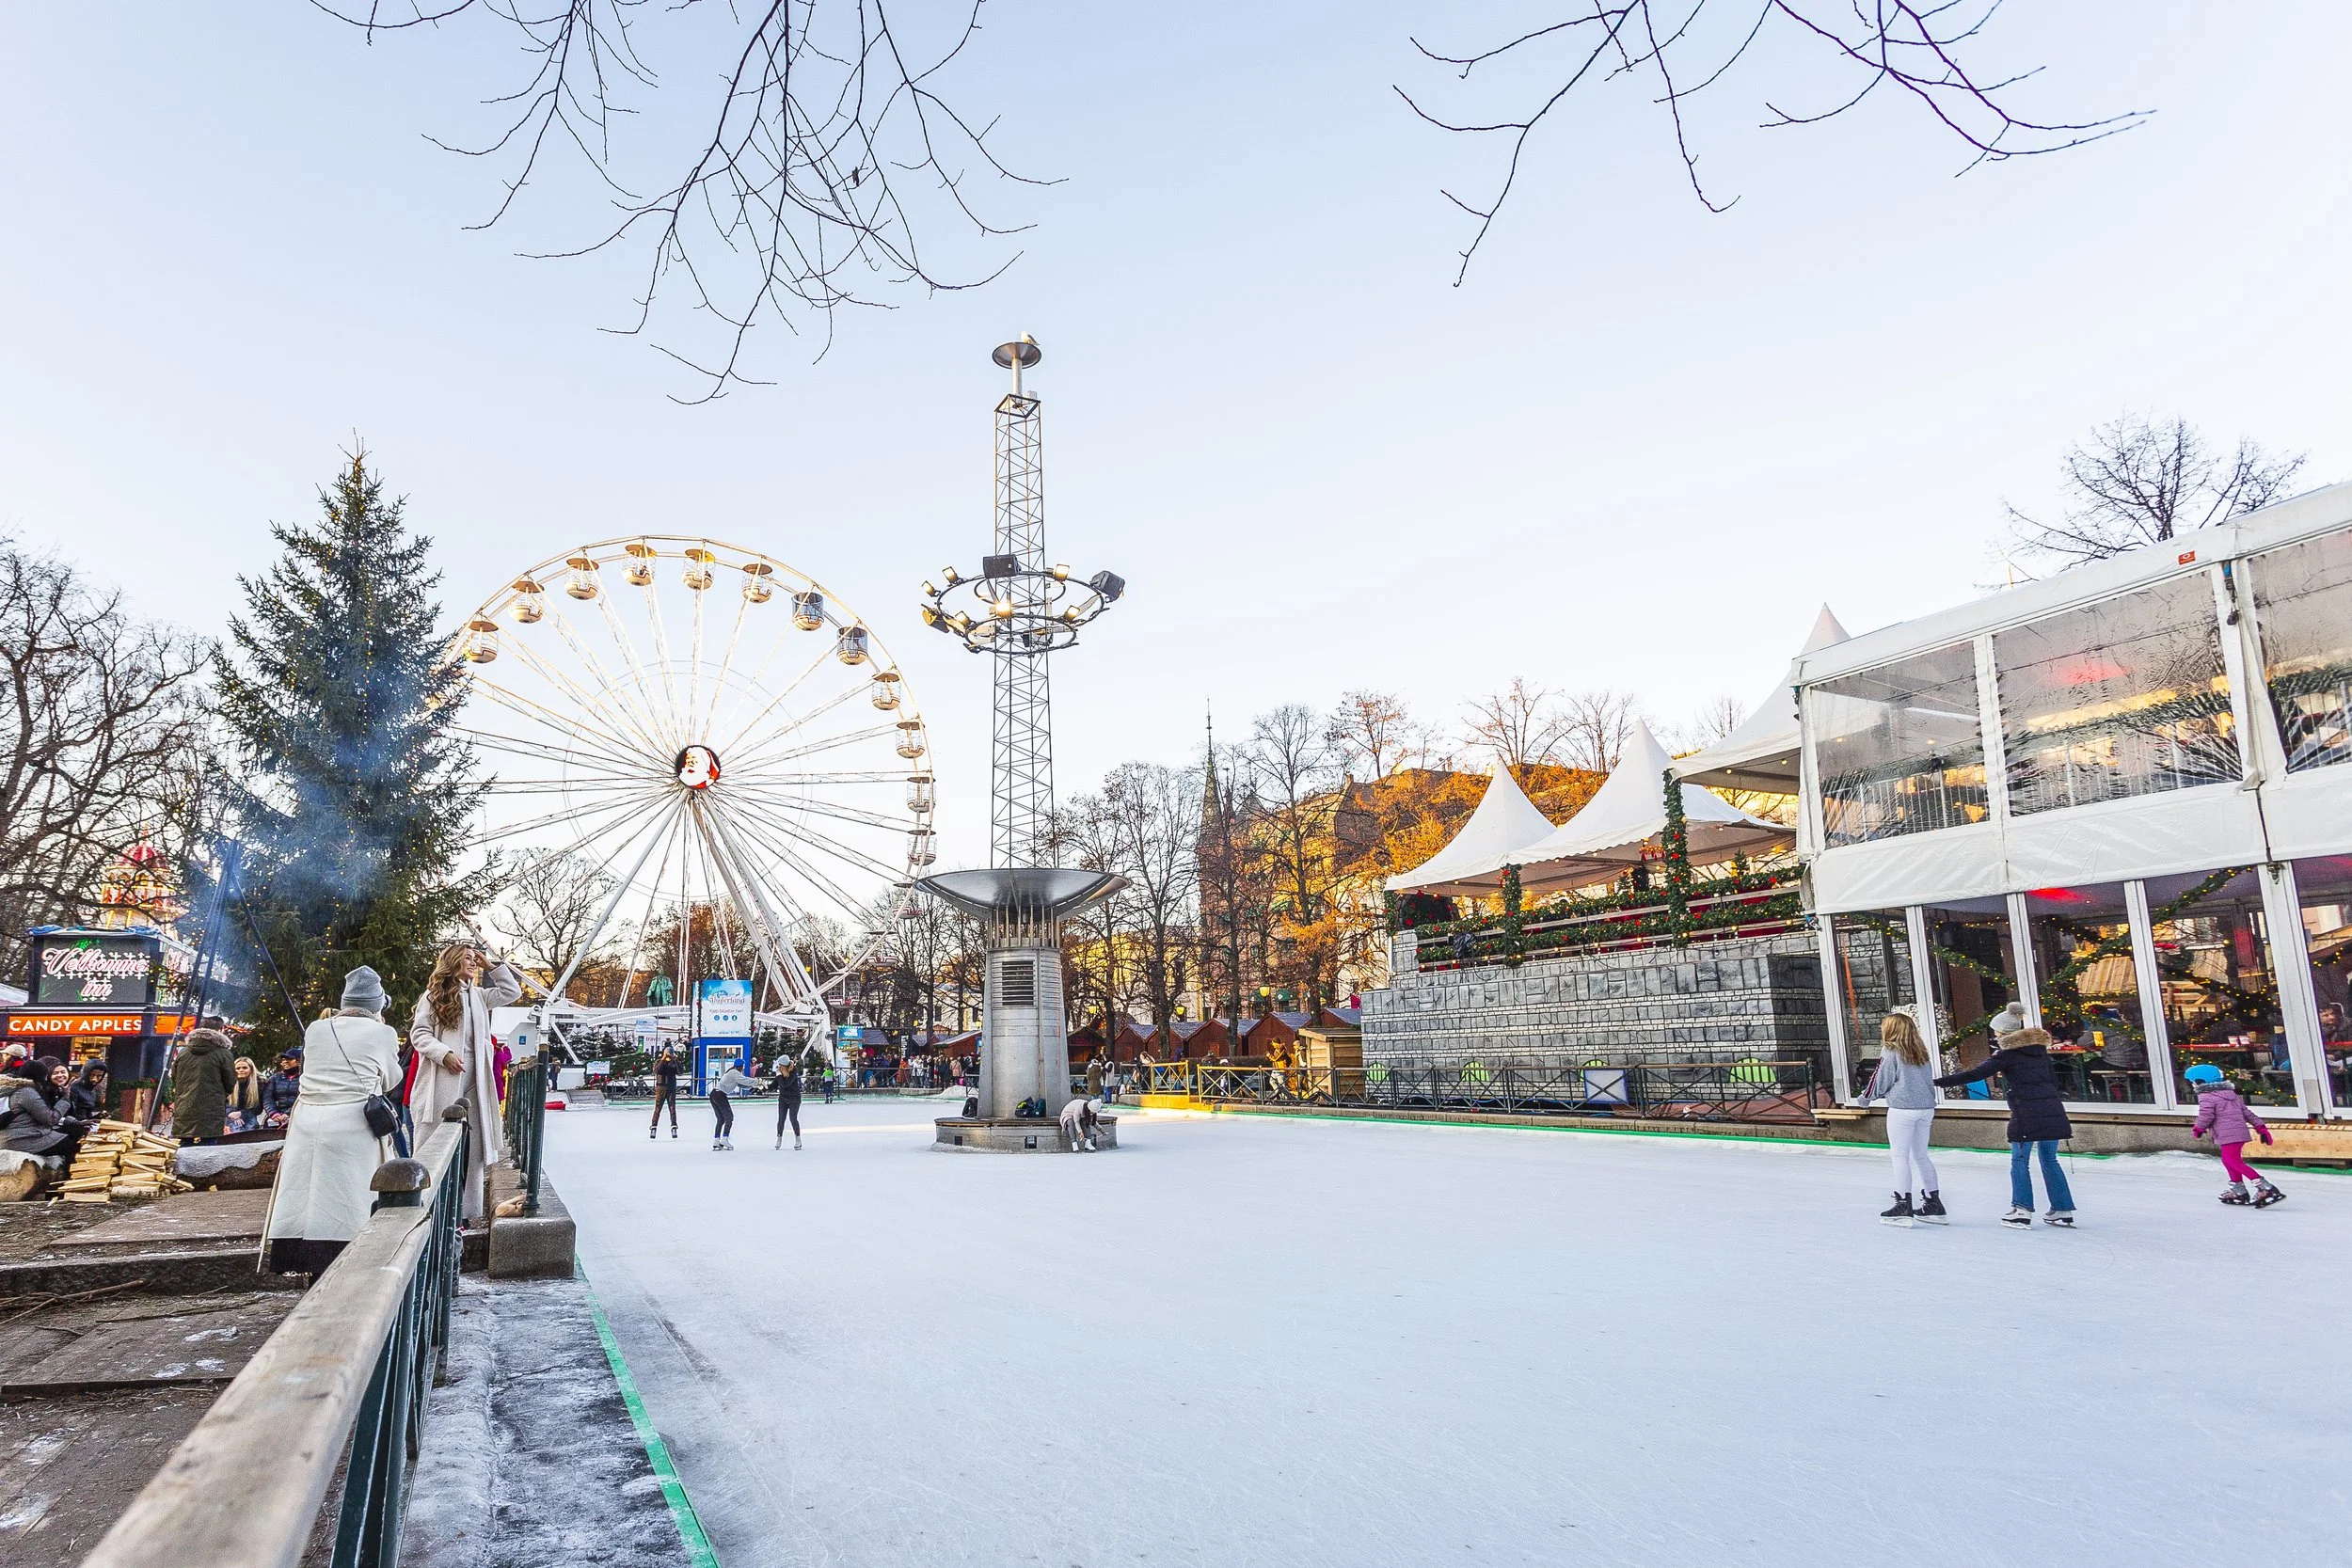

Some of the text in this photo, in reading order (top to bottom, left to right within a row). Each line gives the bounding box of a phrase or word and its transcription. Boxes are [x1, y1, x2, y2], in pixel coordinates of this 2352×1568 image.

[81, 980, 113, 997] inn
[9, 1019, 142, 1032] CANDY APPLES
